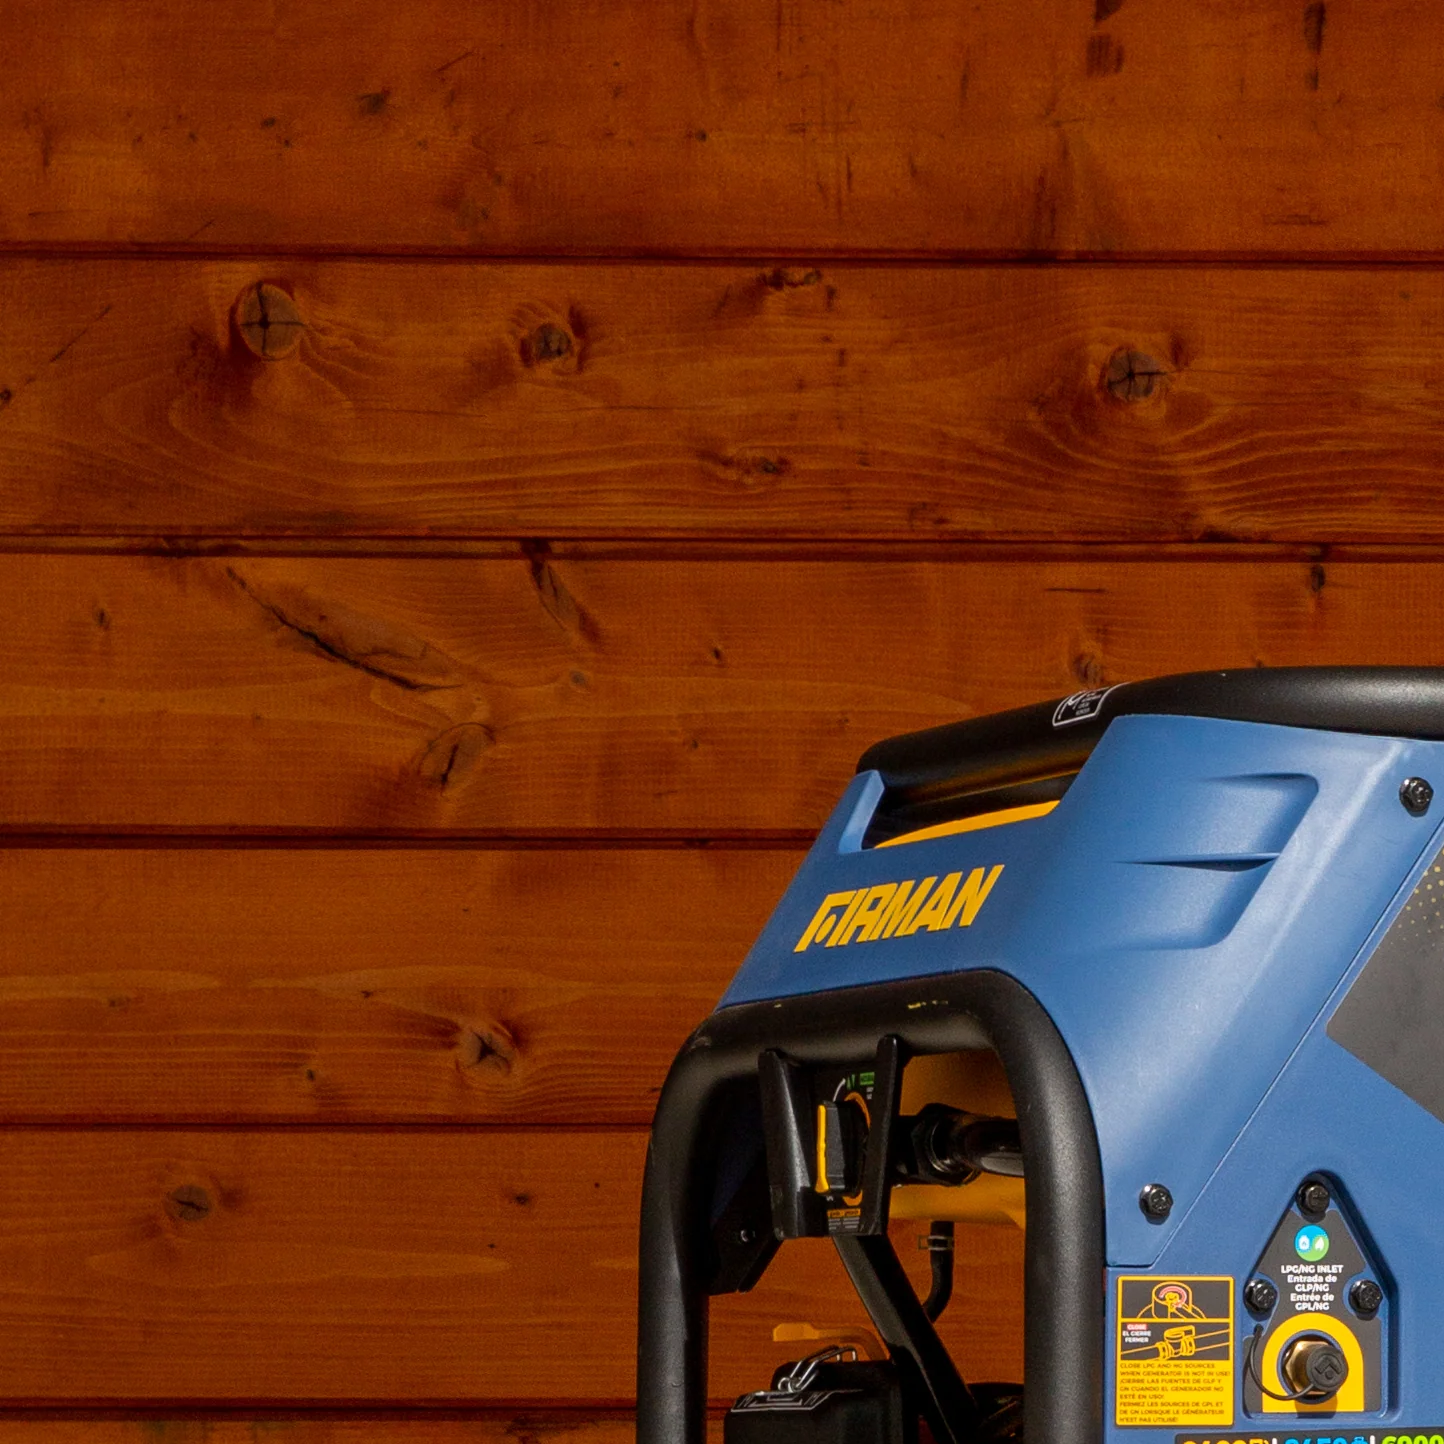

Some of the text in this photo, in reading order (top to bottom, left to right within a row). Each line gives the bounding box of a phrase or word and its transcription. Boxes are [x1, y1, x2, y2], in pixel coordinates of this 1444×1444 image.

[793, 864, 1005, 953] FIRMAN
[1281, 1265, 1344, 1274] LPG/NG INLET
[1288, 1275, 1322, 1283] Entrada
[1295, 1284, 1329, 1292] GLP/NG
[1290, 1293, 1320, 1301] Entrée
[1295, 1302, 1329, 1311] GPL/NG
